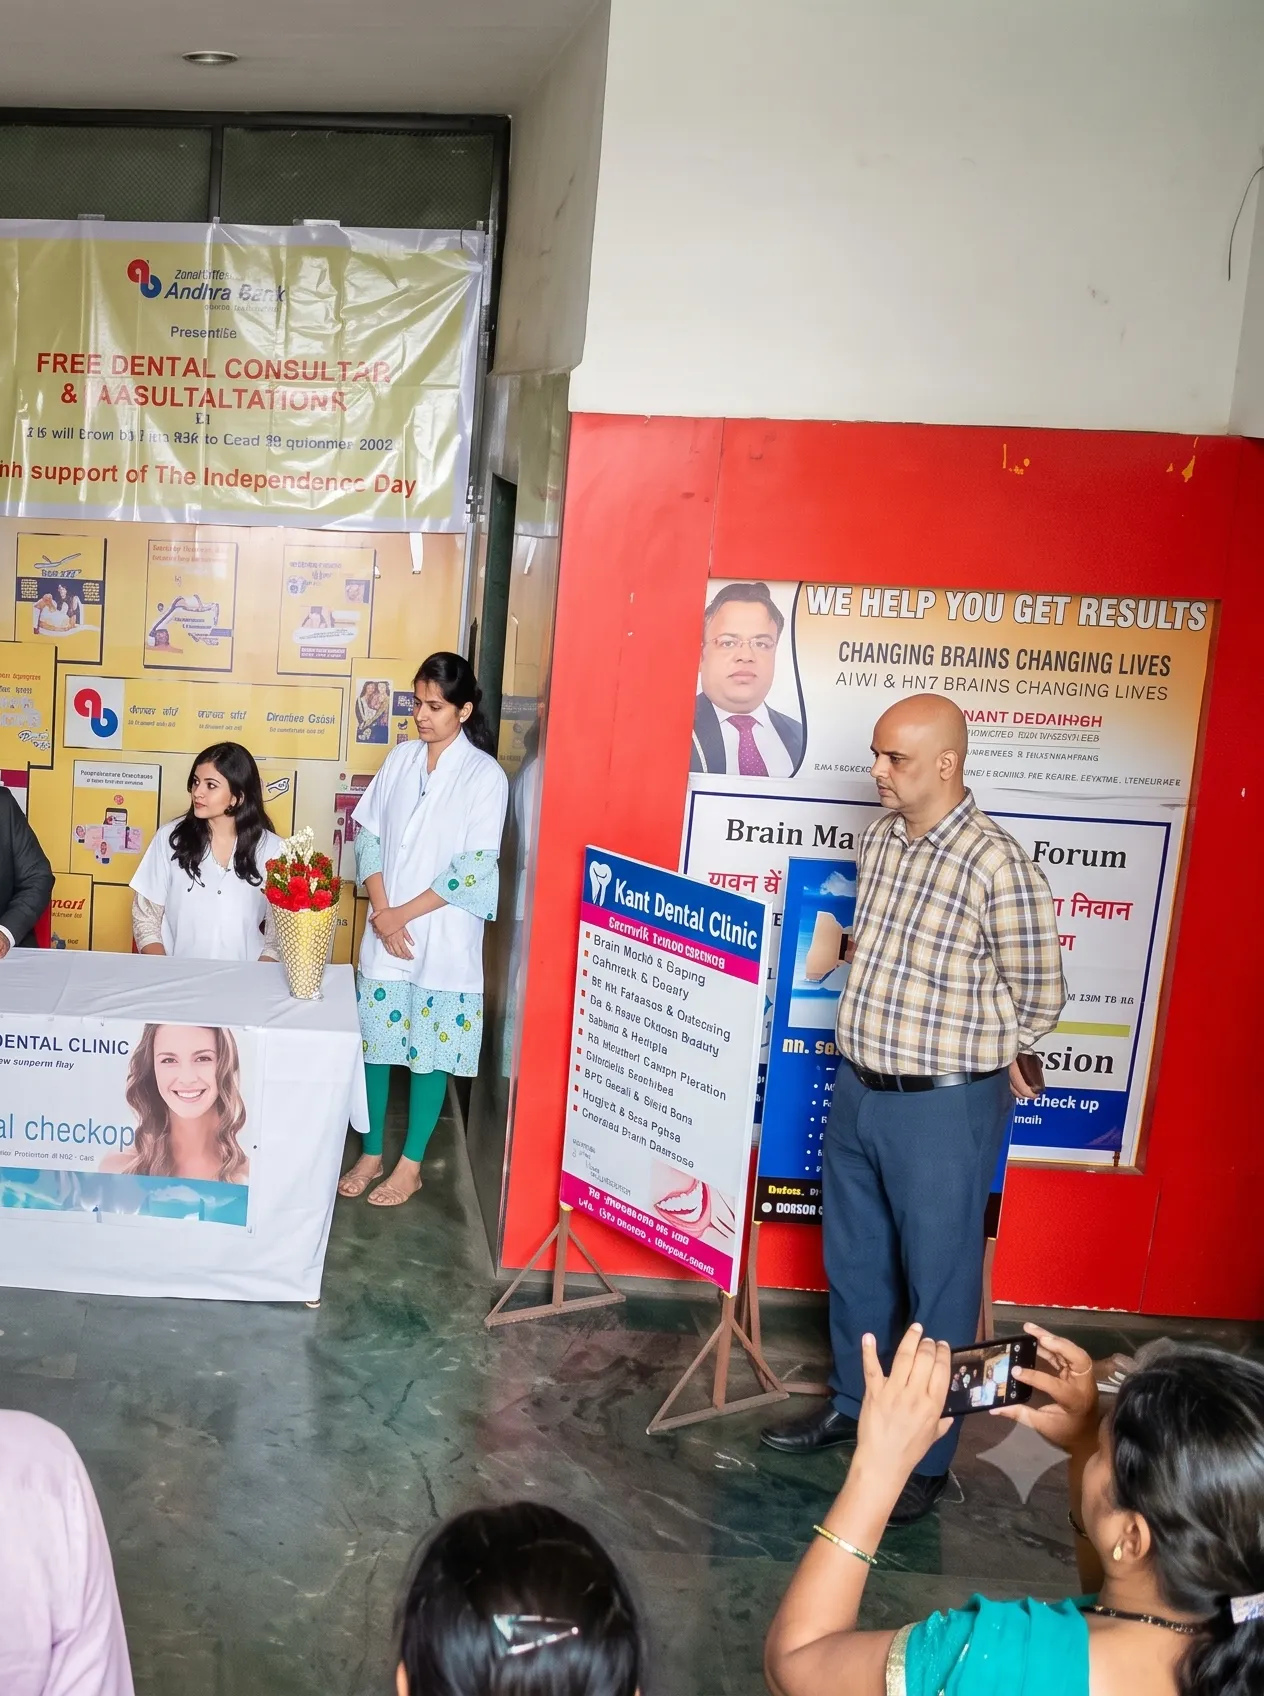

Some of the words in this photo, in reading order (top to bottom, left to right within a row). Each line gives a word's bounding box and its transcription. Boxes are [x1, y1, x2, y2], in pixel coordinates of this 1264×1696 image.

[164, 282, 231, 301] Andhra
[37, 352, 103, 375] FREE
[111, 355, 216, 379] DENTAL
[61, 383, 78, 404] &
[52, 427, 74, 439] will
[205, 434, 218, 445] to
[360, 438, 393, 451] 2002
[31, 464, 118, 486] support
[126, 465, 148, 484] of
[155, 465, 196, 485] The
[374, 473, 417, 498] Day
[805, 585, 853, 617] WE
[860, 587, 937, 620] HELP
[945, 590, 1006, 624] YOU
[1013, 593, 1072, 626] GET
[1077, 596, 1208, 632] RESULTS
[838, 641, 935, 668] CHANGING
[940, 645, 1010, 670] BRAINS
[1016, 648, 1113, 675] CHANGING
[1118, 652, 1172, 678] LIVES
[883, 675, 896, 688] &
[943, 677, 1010, 694] BRAINS
[1015, 679, 1110, 697] CHANGING
[725, 818, 803, 847] Brain
[1032, 840, 1127, 868] Forum
[615, 878, 650, 914] Kant
[654, 893, 705, 933] Dental
[709, 911, 758, 950] Clinic
[594, 934, 620, 954] Brain
[666, 1004, 674, 1018] &
[621, 1027, 628, 1038] &
[68, 1037, 130, 1056] CLINIC
[633, 1091, 640, 1101] &
[1033, 1094, 1077, 1110] check
[1080, 1099, 1100, 1114] up
[24, 1115, 135, 1152] checkop
